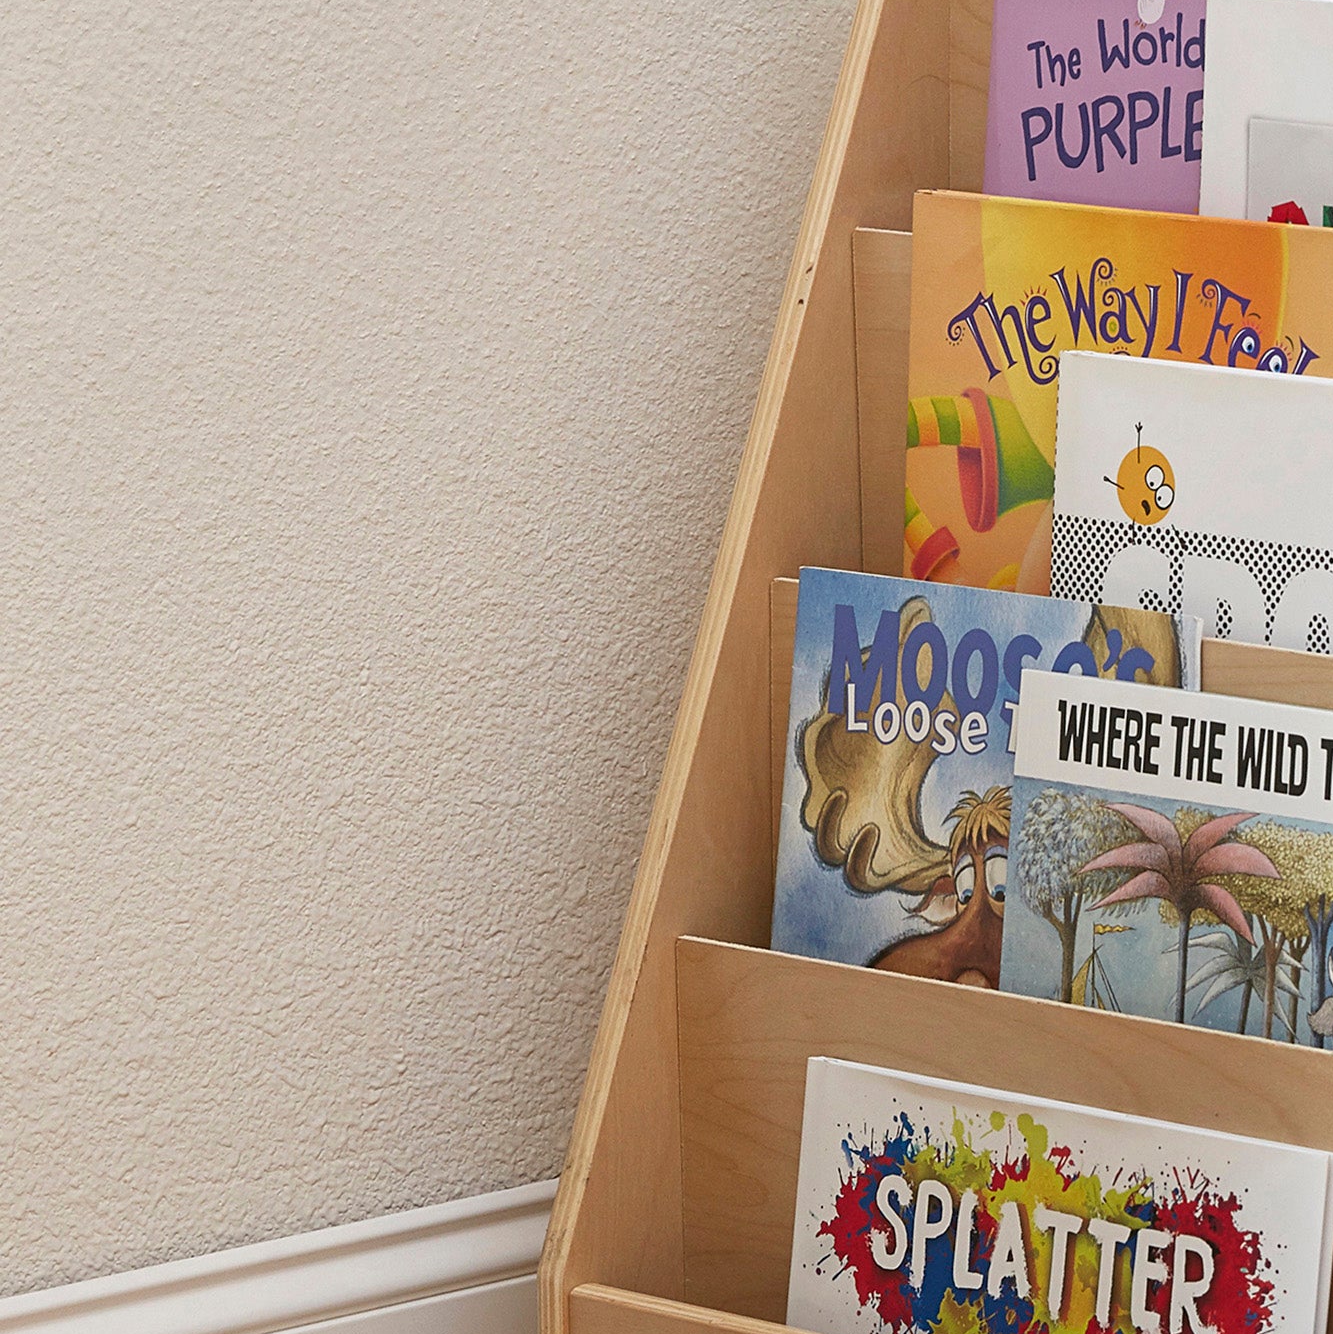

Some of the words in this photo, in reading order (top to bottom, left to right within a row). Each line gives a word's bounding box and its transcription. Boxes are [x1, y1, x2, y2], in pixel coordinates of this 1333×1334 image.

[1027, 40, 1081, 89] The
[1097, 12, 1205, 74] World
[1020, 86, 1203, 182] PURPLE
[947, 288, 1059, 386] The
[1049, 257, 1162, 357] Way
[1165, 268, 1194, 354] I
[846, 683, 990, 756] Loose
[1058, 699, 1163, 775] WHERE
[1170, 714, 1226, 784] THE
[1236, 725, 1309, 797] WILD
